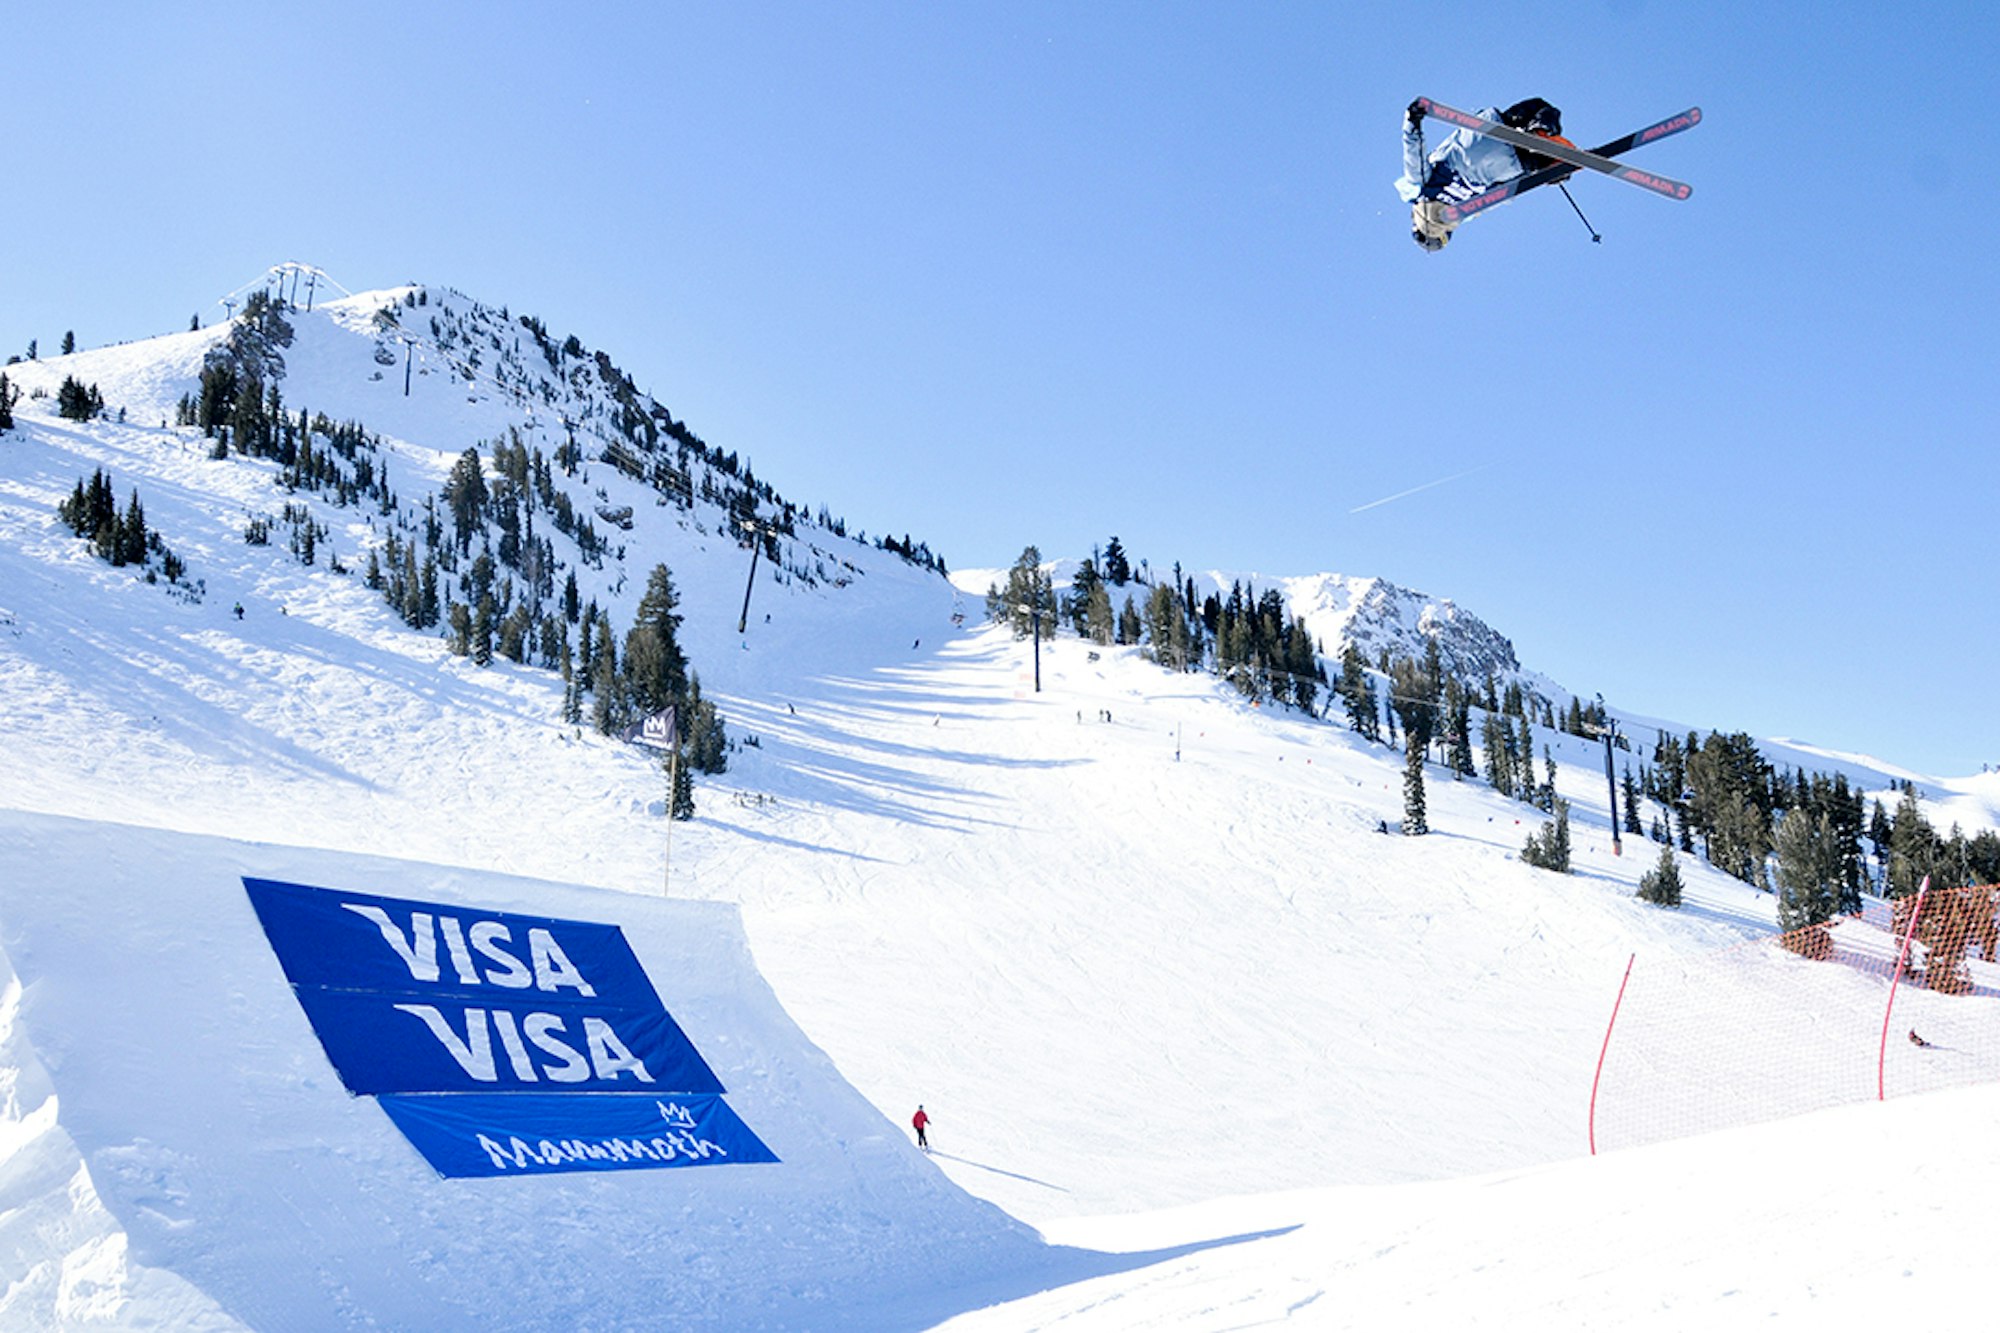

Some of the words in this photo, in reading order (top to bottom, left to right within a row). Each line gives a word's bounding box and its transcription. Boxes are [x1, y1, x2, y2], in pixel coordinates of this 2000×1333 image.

[340, 902, 597, 998] VISA
[393, 1003, 656, 1083] VISA
[475, 1128, 727, 1169] Mammoth
